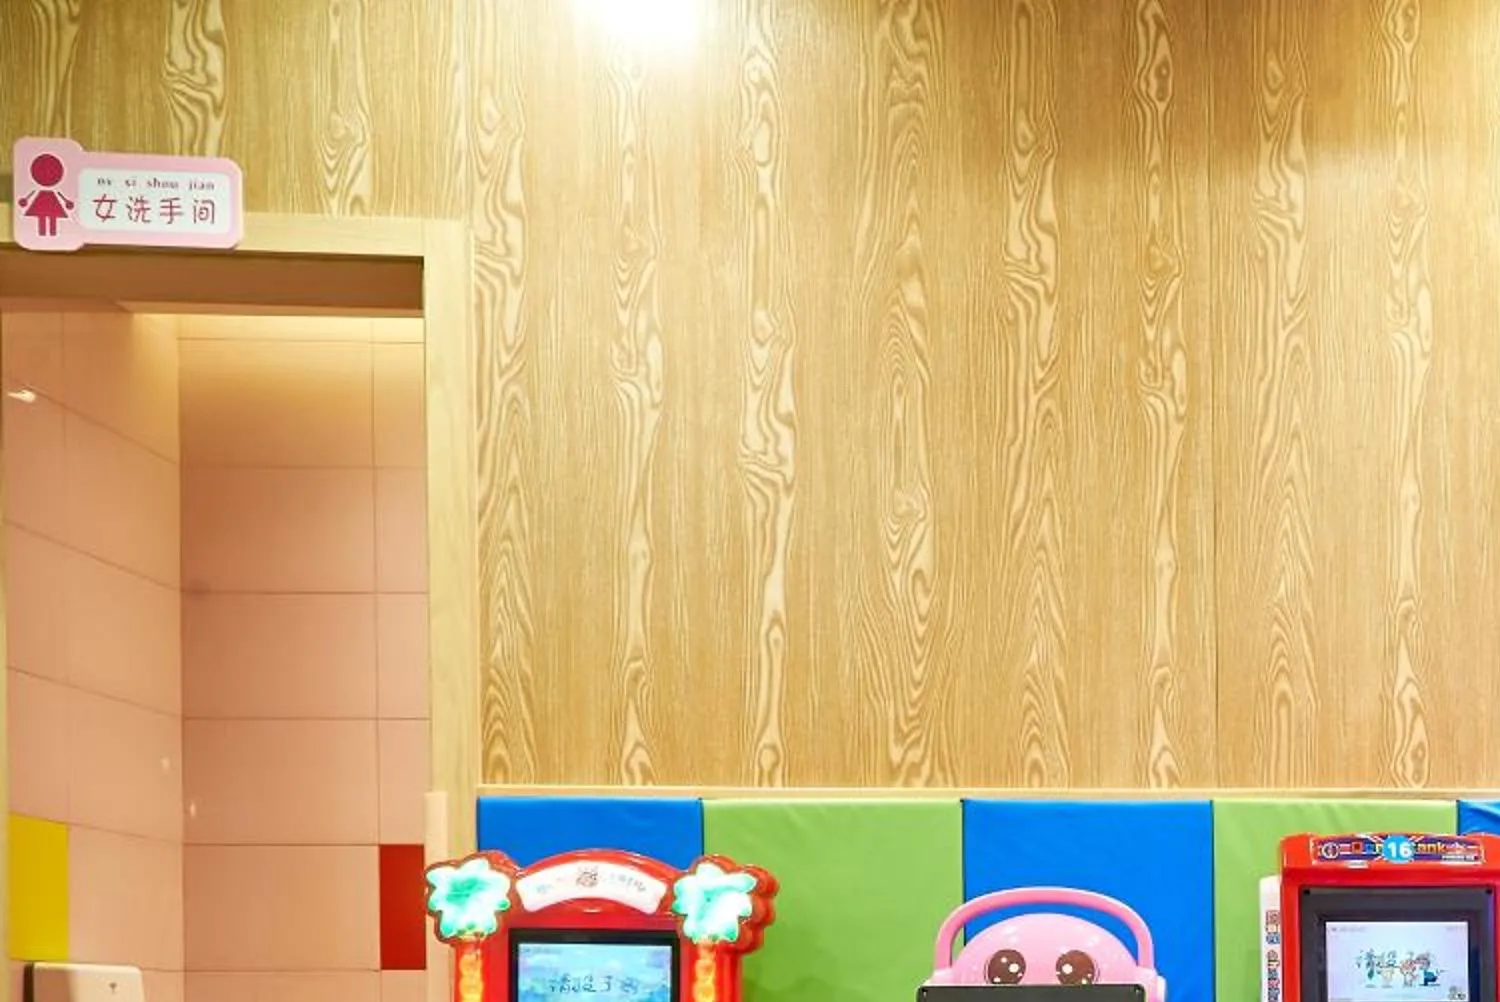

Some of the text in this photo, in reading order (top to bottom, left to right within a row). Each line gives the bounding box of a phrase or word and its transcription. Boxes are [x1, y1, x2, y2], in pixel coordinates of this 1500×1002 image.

[146, 176, 179, 189] shou
[188, 178, 215, 191] jian
[92, 193, 216, 224] 女洗手间
[1387, 841, 1412, 858] 16
